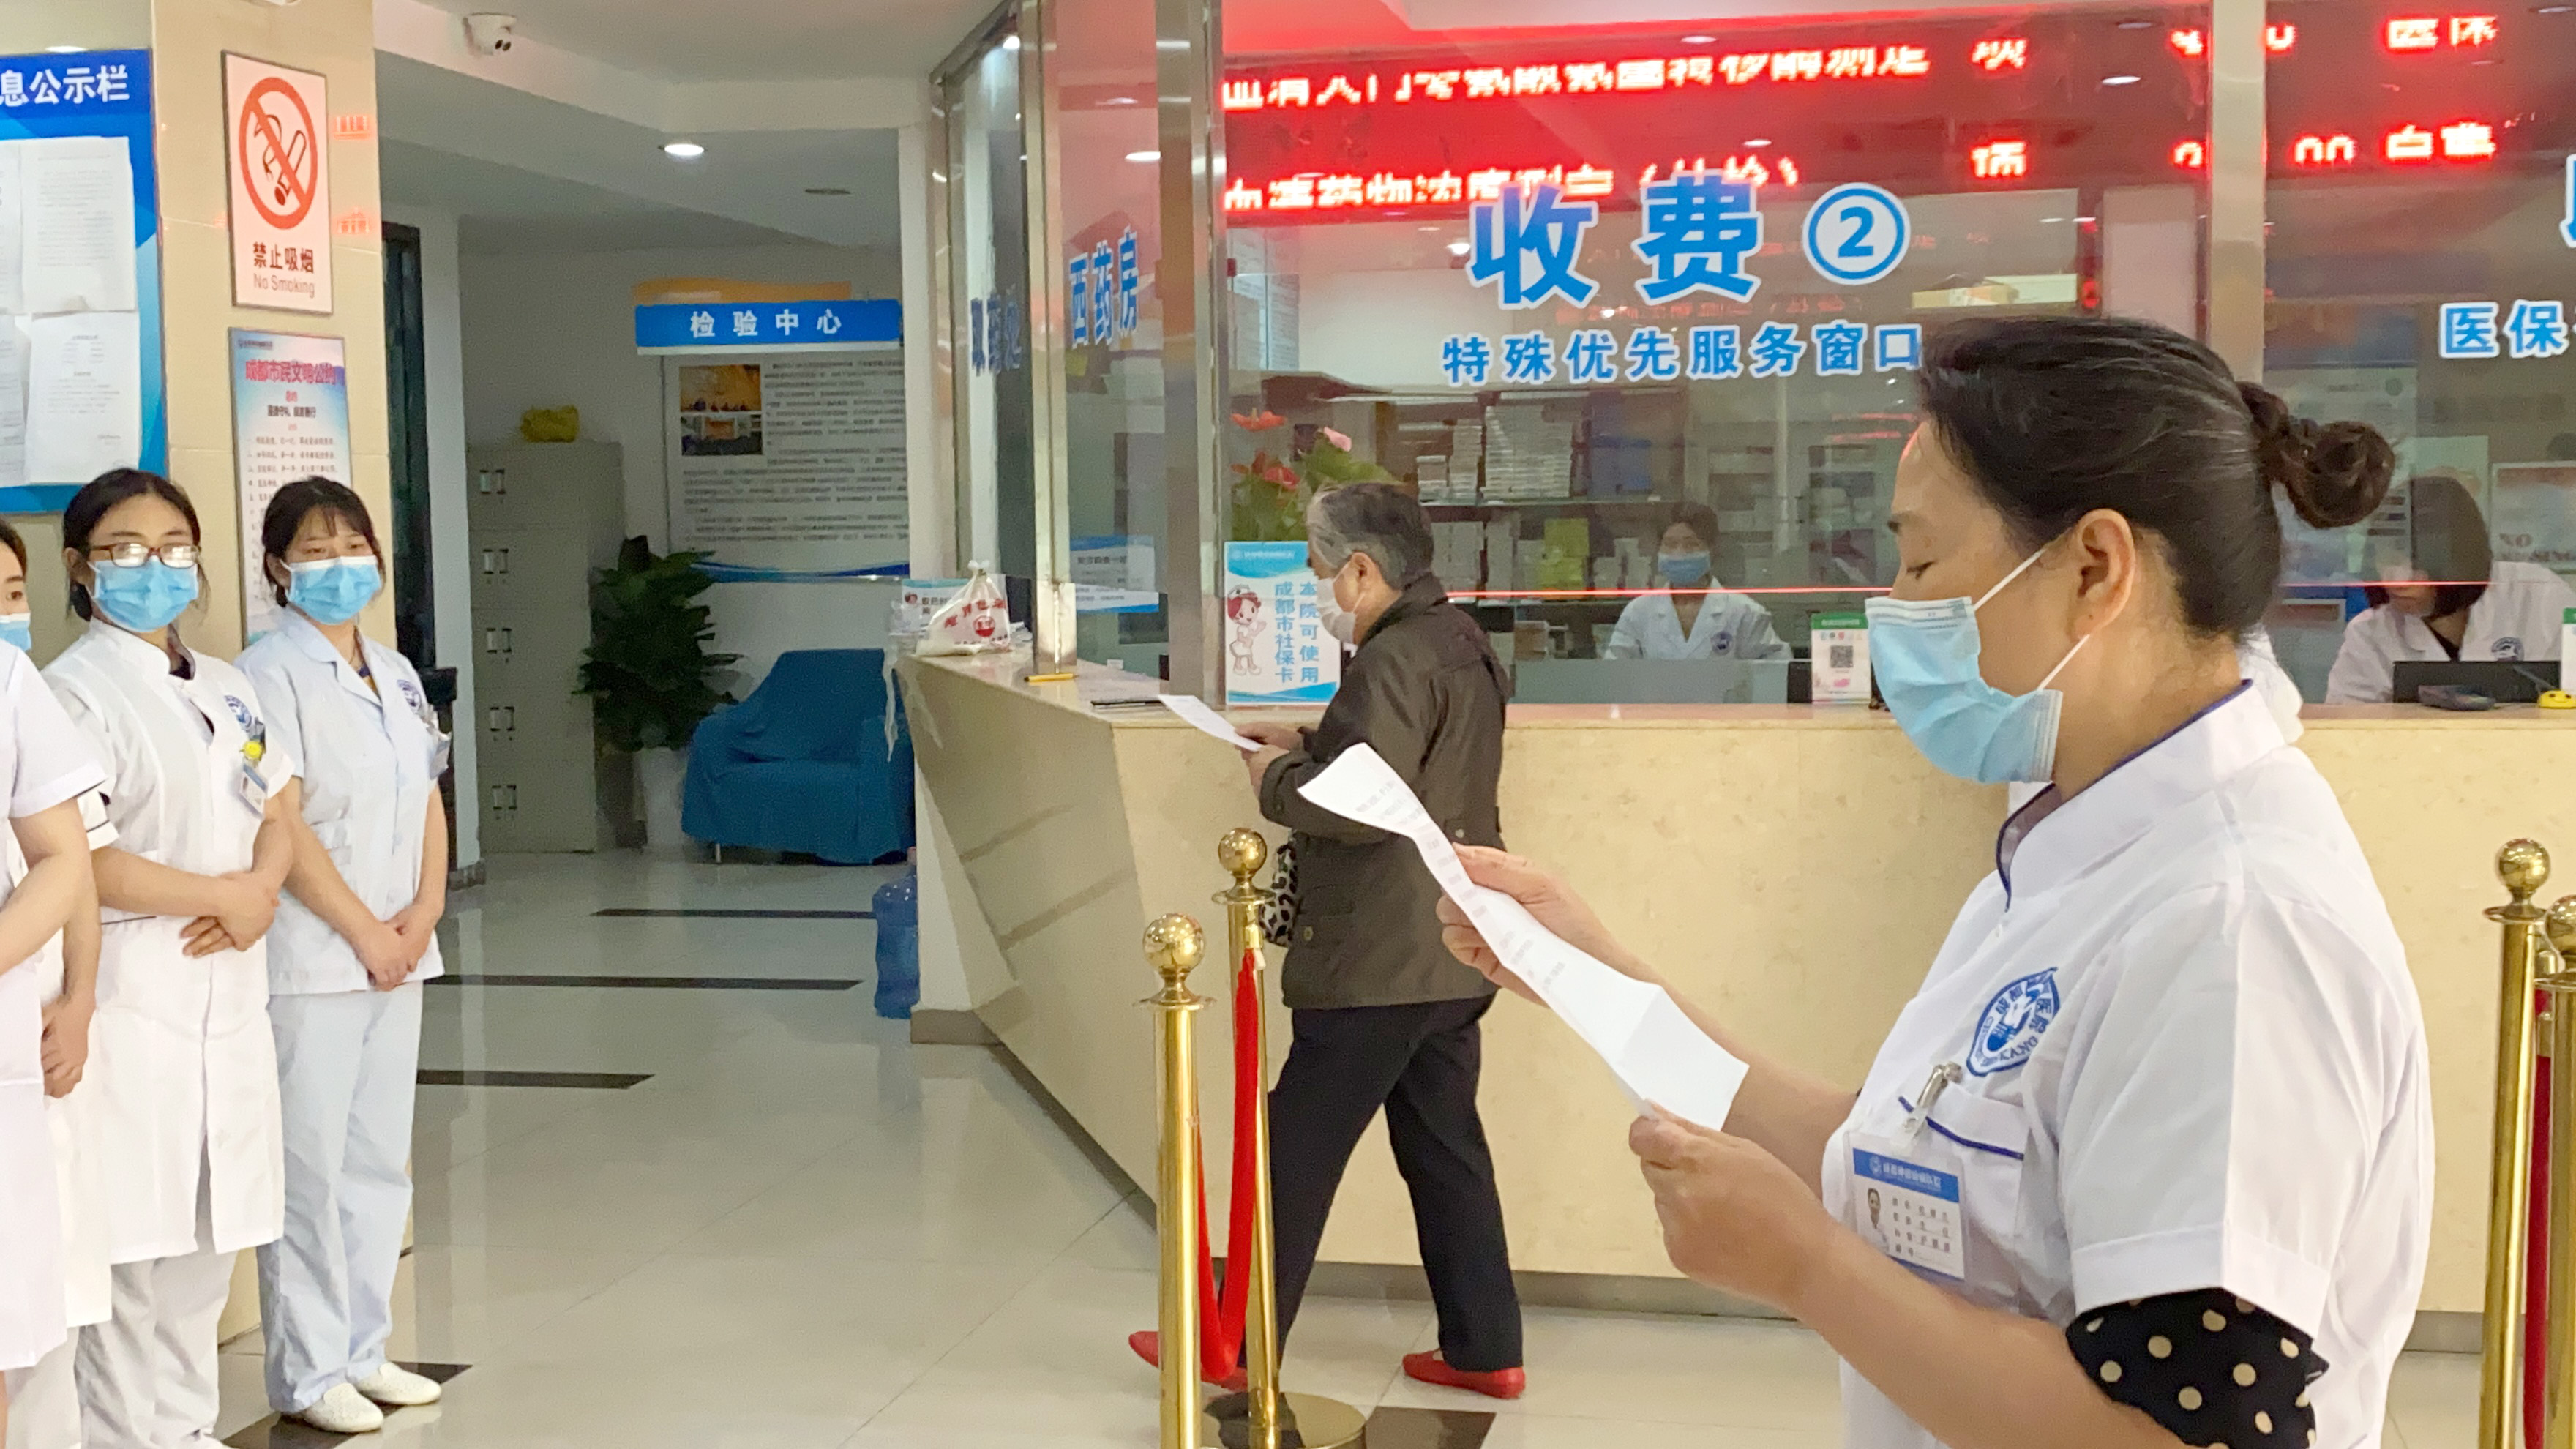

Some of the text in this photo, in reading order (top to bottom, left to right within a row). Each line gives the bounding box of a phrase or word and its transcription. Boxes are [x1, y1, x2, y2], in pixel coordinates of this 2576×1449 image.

[0, 64, 130, 107] 息公示栏
[252, 242, 314, 274] 禁止吸烟
[1469, 171, 1761, 306] 收费
[253, 273, 315, 299] No Smoking
[1069, 226, 1139, 348] 西药房
[689, 307, 842, 338] 检验中心
[1442, 323, 1922, 385] 特殊优先服务窗口
[1274, 581, 1295, 683] 成都市社保卡
[1299, 581, 1320, 683] 本院可使用
